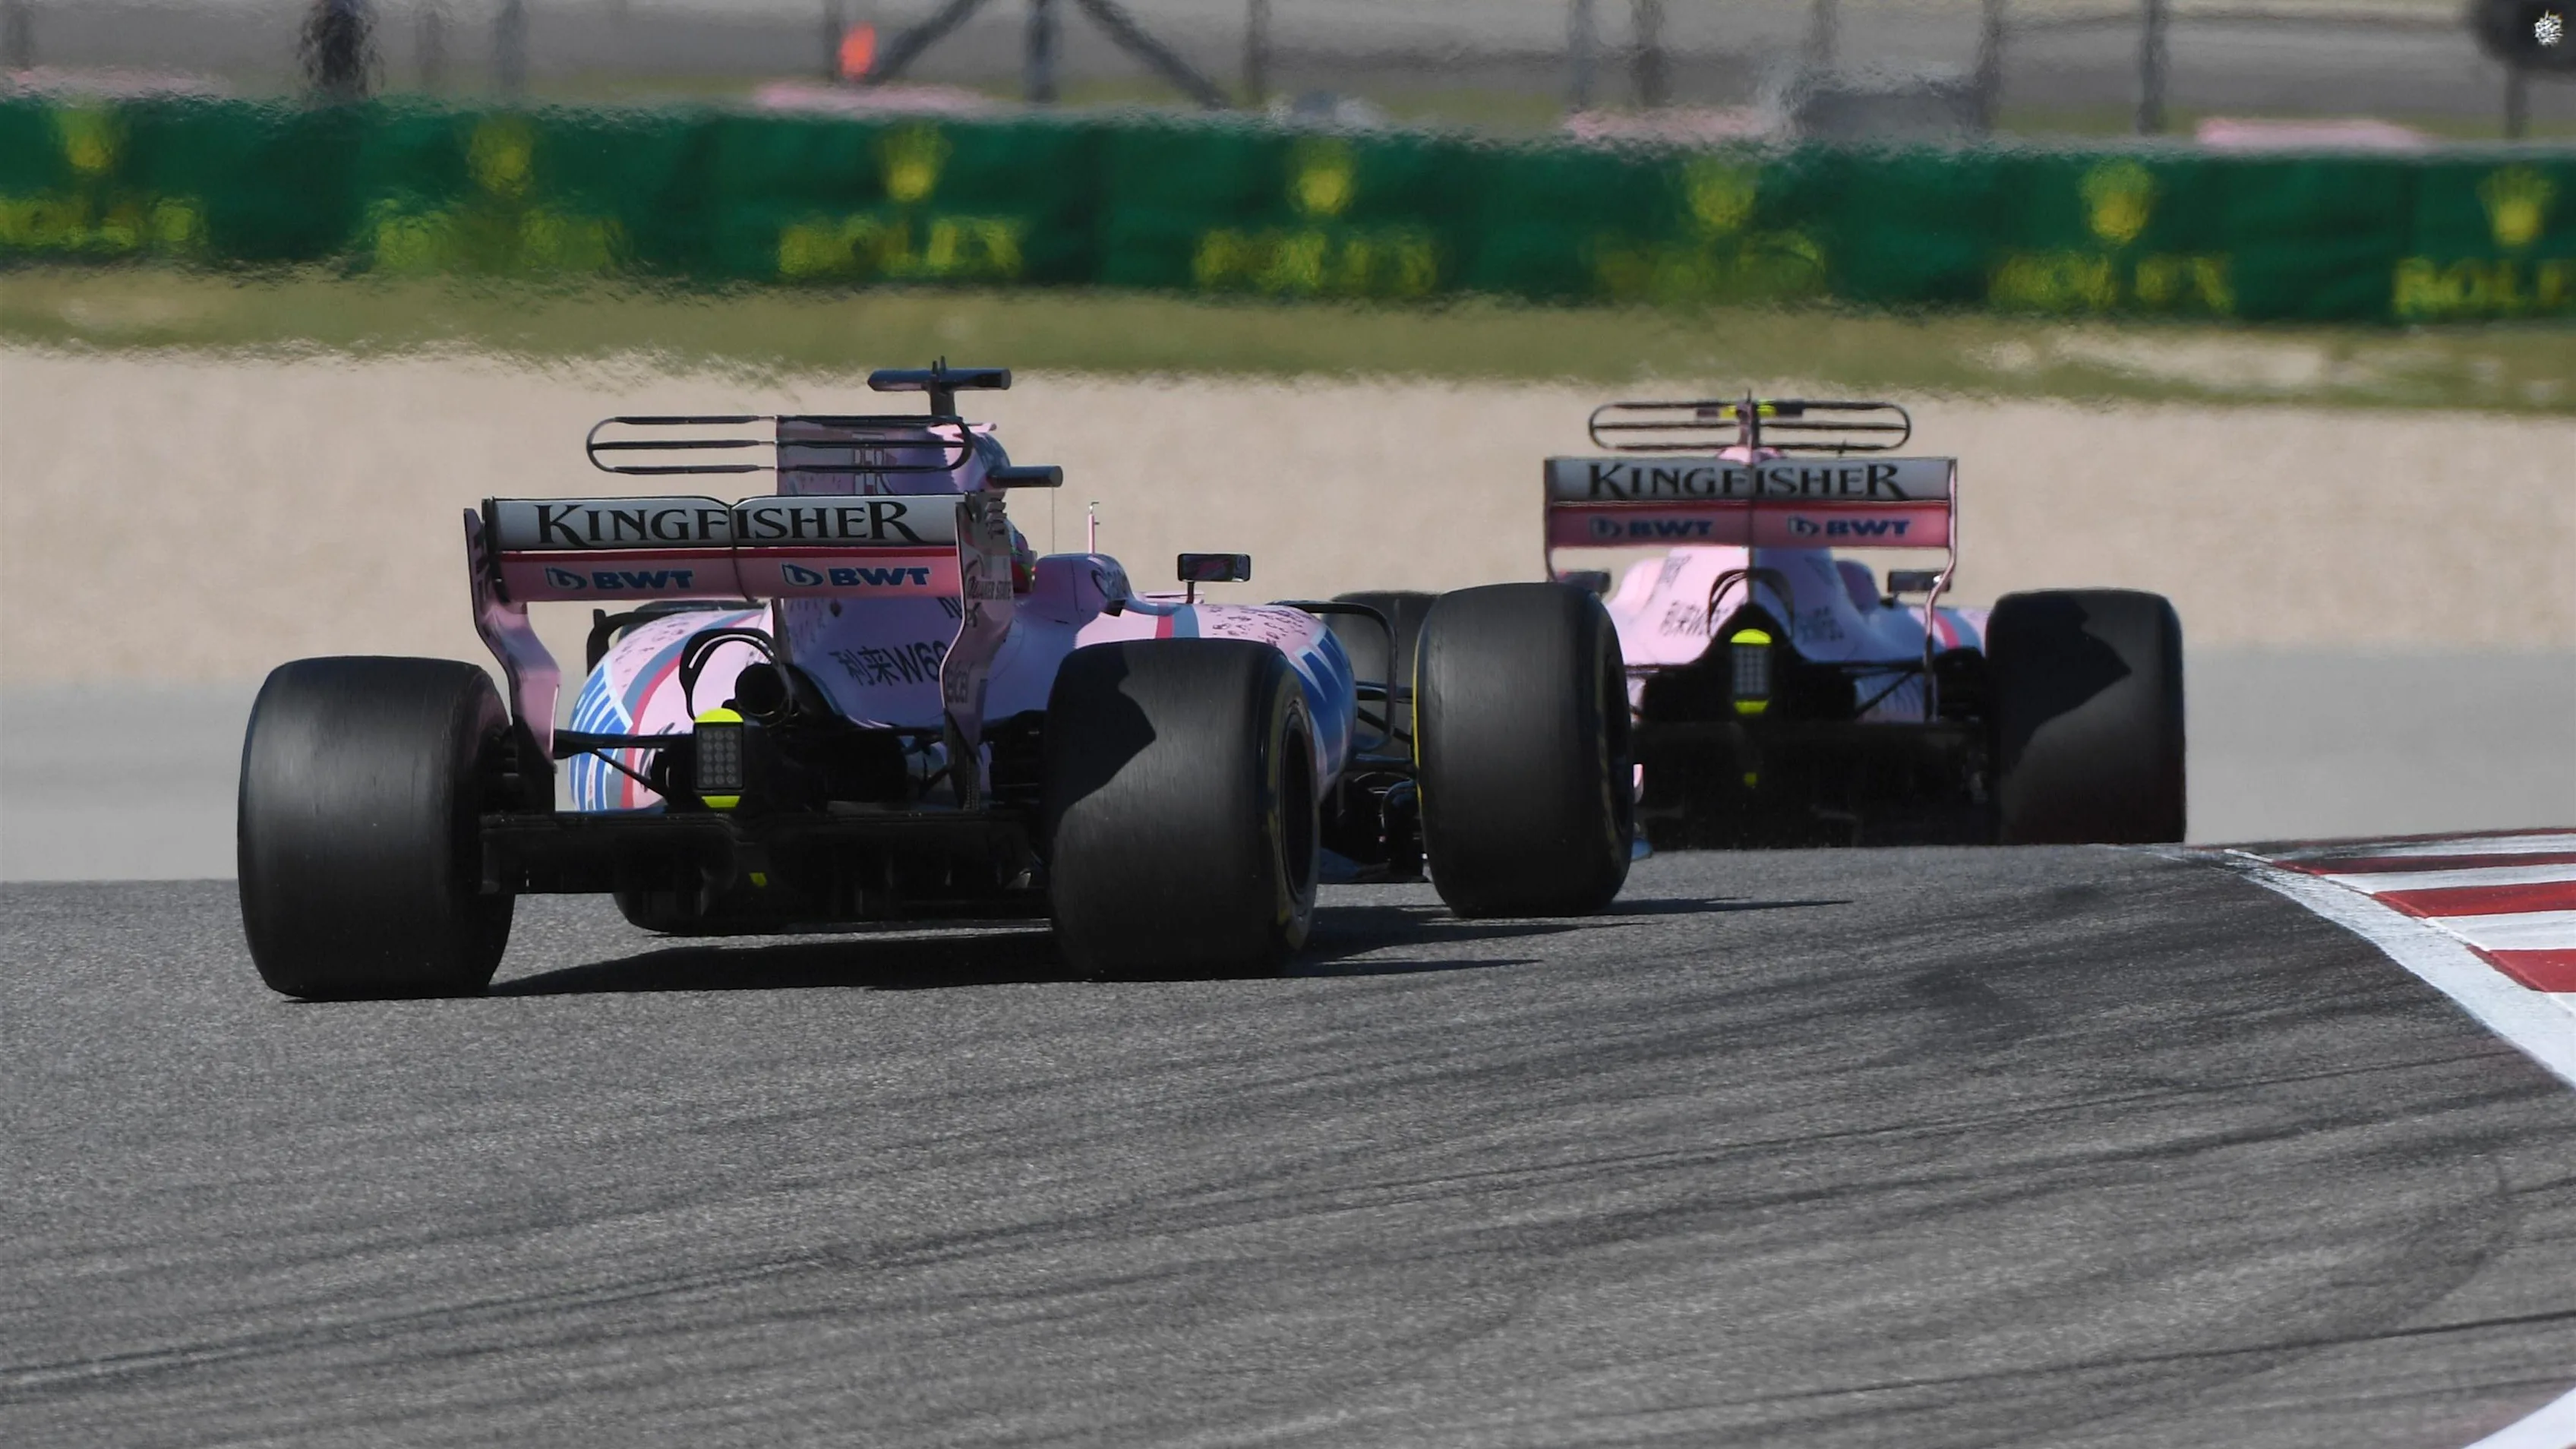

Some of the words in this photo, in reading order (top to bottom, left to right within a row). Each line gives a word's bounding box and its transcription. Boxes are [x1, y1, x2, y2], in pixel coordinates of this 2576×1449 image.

[1589, 462, 1911, 500] KINGFISHER
[535, 500, 928, 548] KINGFISHER
[1627, 520, 1714, 537] BWT
[1826, 518, 1911, 537] BWT
[592, 570, 694, 590] BWT
[828, 568, 931, 586] BWT
